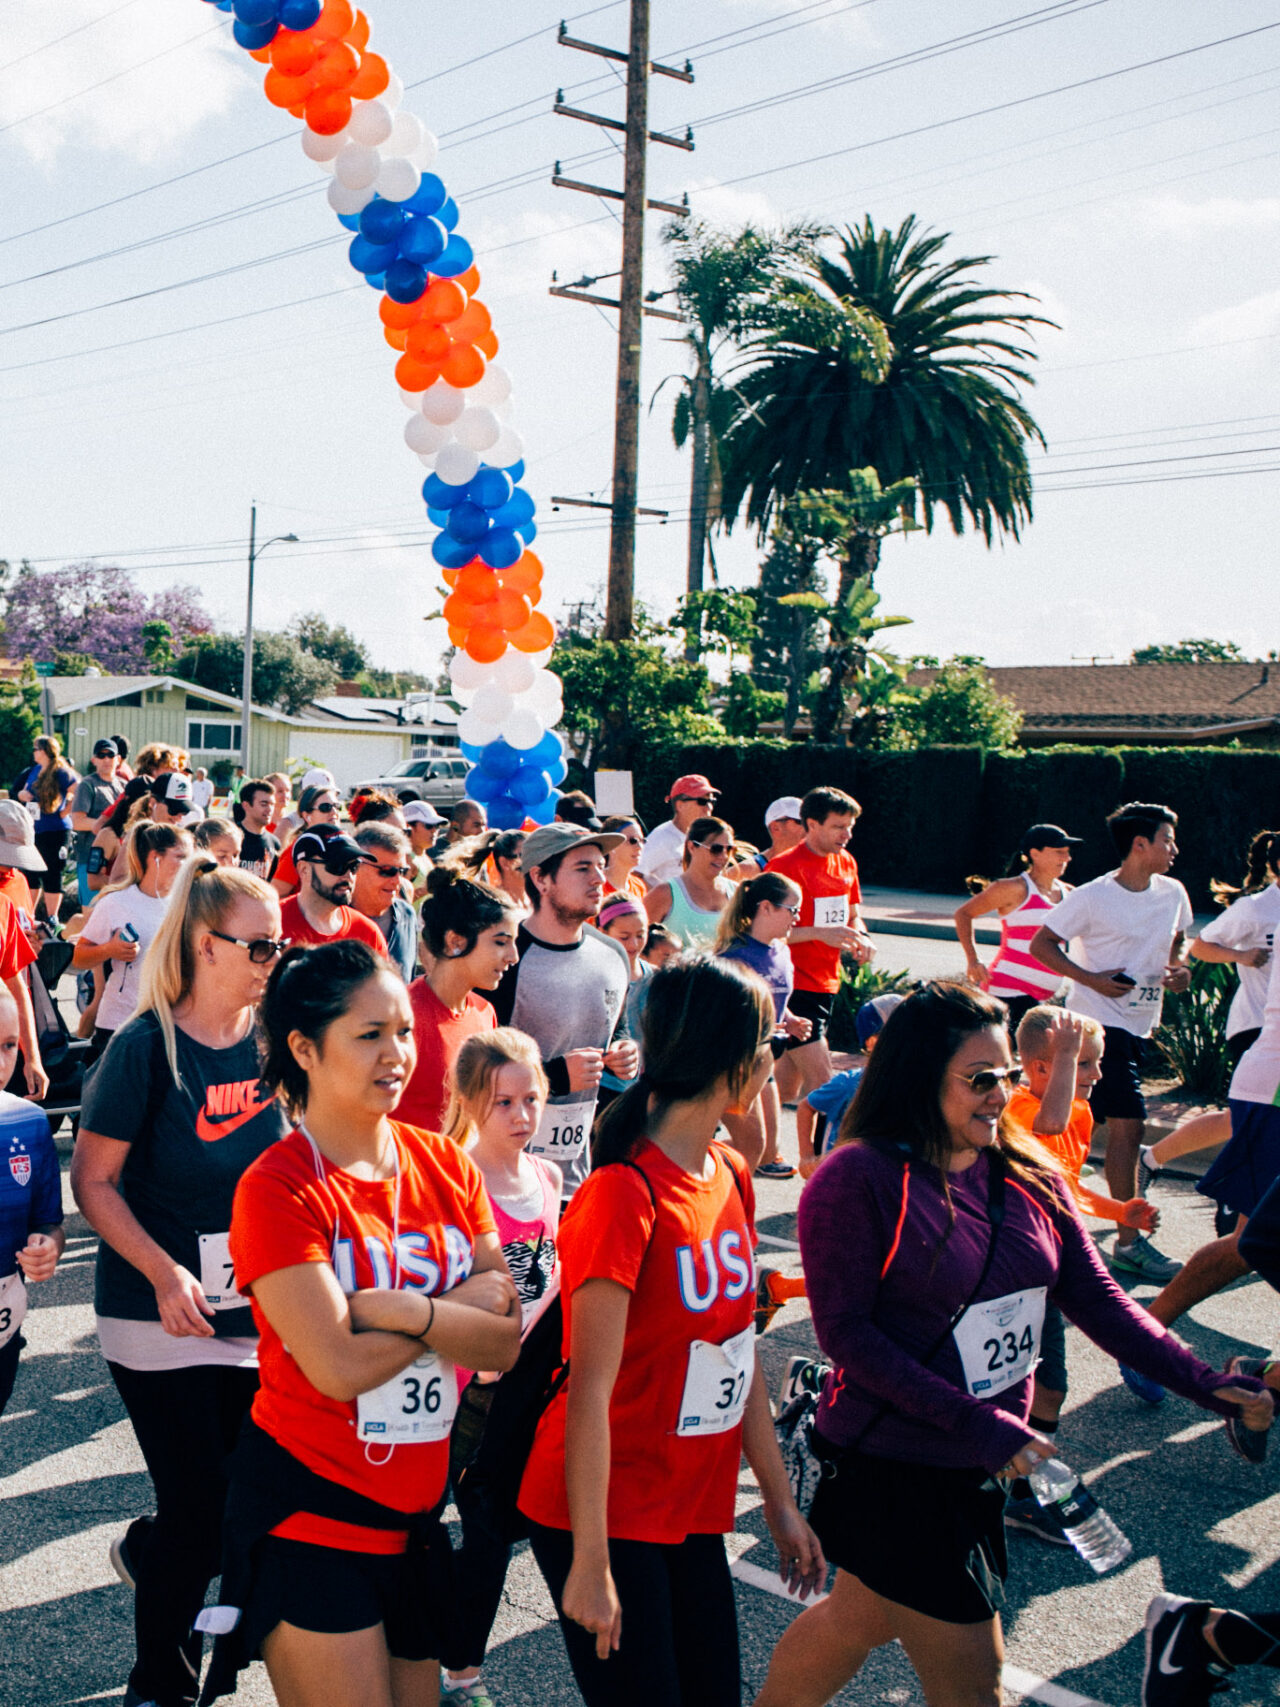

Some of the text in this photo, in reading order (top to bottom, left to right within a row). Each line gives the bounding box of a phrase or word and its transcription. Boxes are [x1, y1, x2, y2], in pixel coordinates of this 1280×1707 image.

[824, 909, 845, 924] 123
[1139, 987, 1161, 1002] 732
[206, 1077, 260, 1116] NIKE
[549, 1124, 584, 1146] 108
[222, 1262, 236, 1290] 7
[334, 1224, 474, 1297] USA
[675, 1223, 757, 1313] US
[983, 1323, 1034, 1372] 234
[401, 1376, 442, 1415] 36
